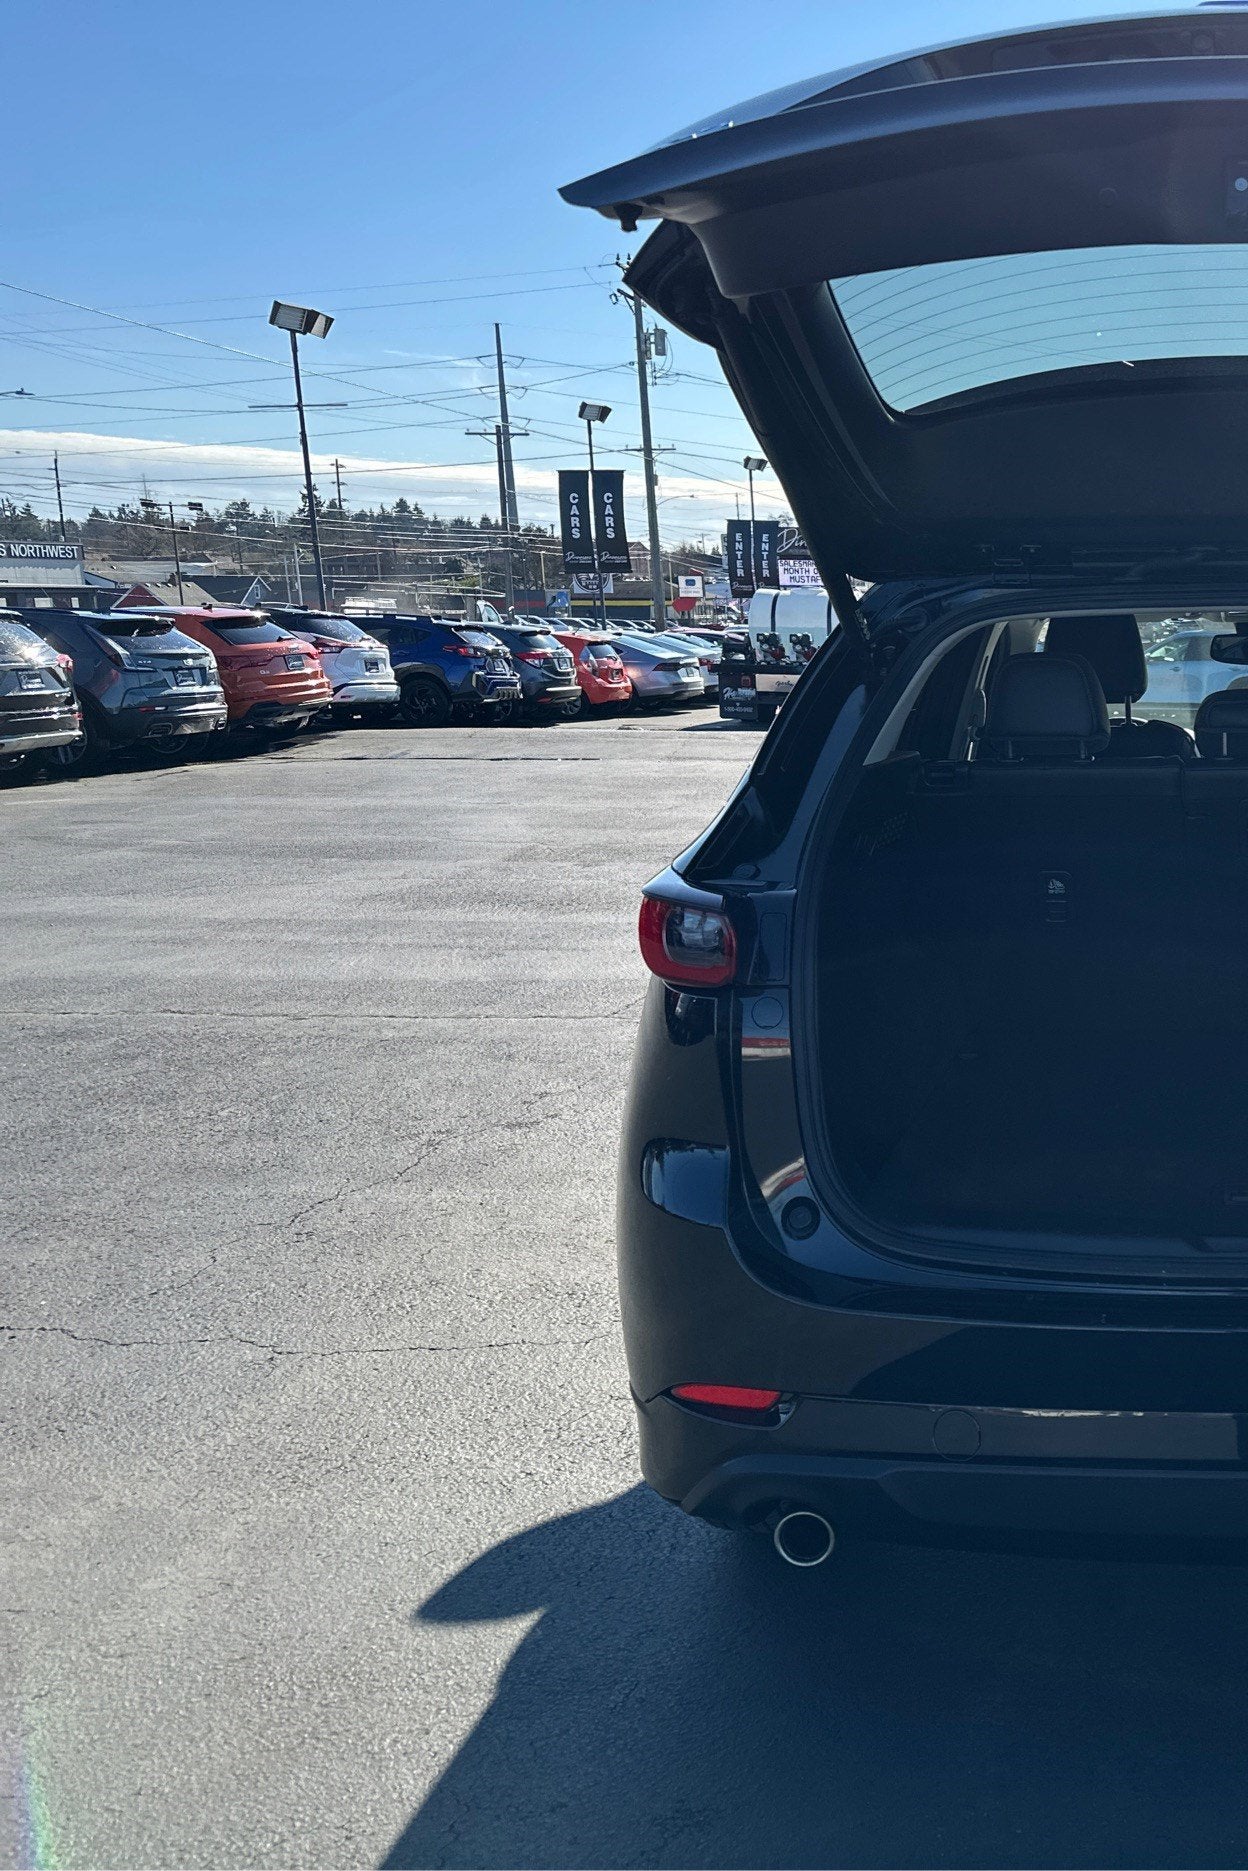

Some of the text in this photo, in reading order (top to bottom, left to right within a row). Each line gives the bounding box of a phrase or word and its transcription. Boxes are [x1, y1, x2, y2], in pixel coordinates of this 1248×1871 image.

[569, 492, 580, 539] CARS
[603, 492, 615, 539] CARS
[10, 543, 78, 558] NORTHWEST
[735, 532, 745, 577] ENTER
[761, 533, 770, 578] ENTER
